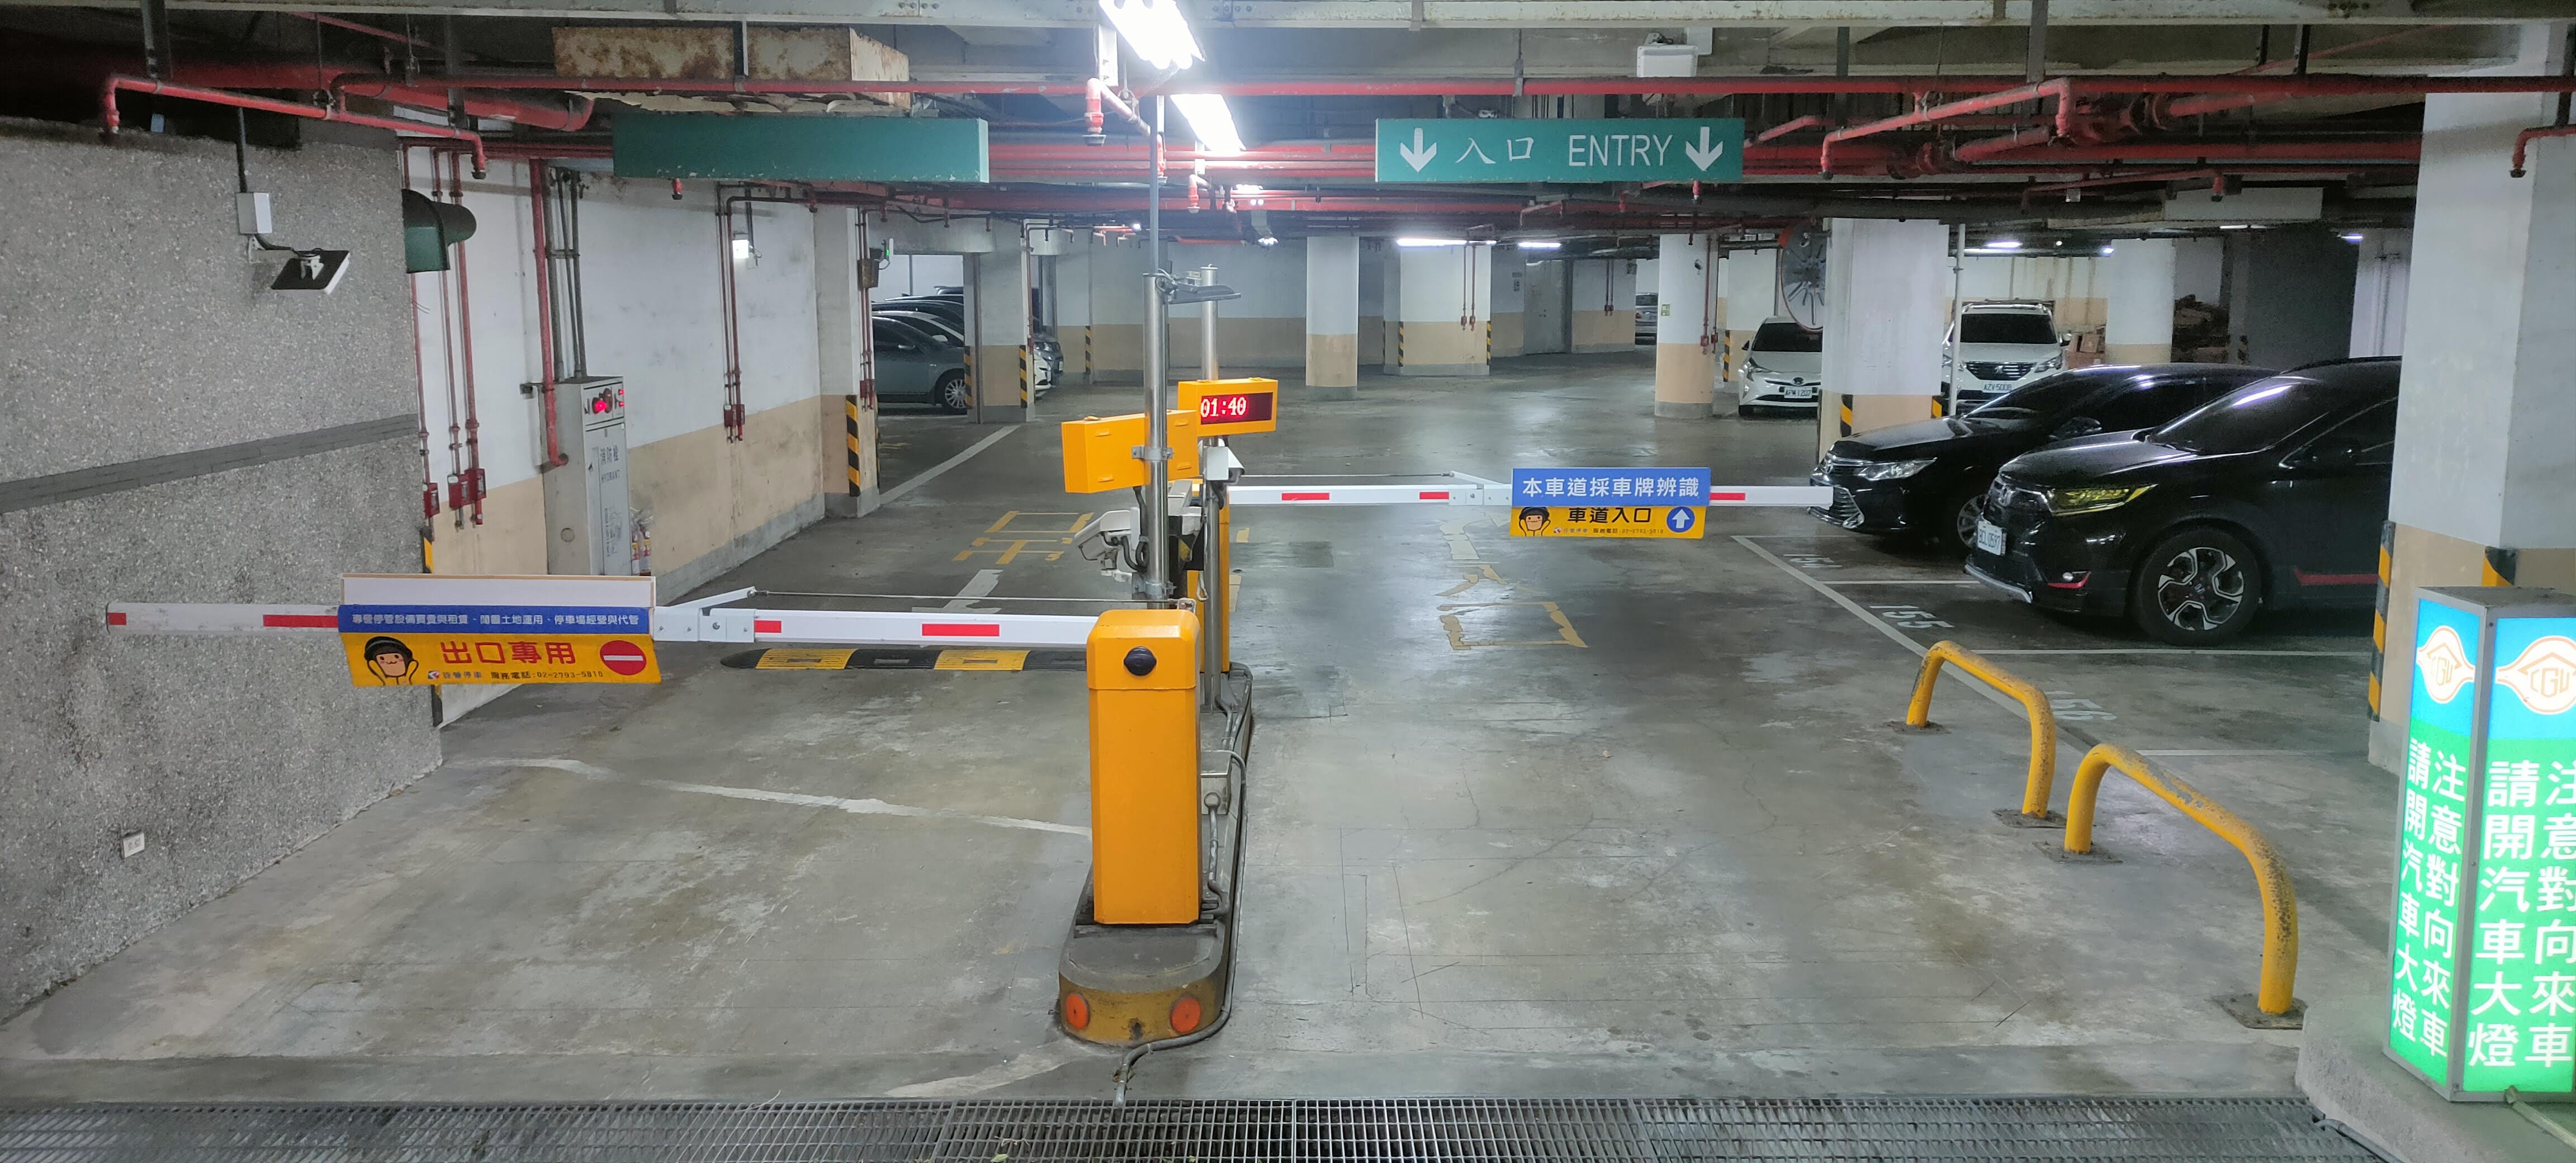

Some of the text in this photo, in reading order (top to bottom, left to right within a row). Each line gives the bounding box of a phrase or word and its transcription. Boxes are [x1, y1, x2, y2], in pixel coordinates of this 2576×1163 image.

[1456, 134, 1673, 167] 入口 ENTRY
[1200, 397, 1247, 418] 01:40
[601, 470, 620, 484] HYDRANT
[1523, 477, 1699, 498] 本車道採車牌辨識
[1567, 507, 1651, 524] 車道入口
[1869, 605, 1955, 628] 155
[441, 640, 576, 665] 出口專用
[2393, 738, 2431, 1042] 請開汽車大燈
[2419, 750, 2467, 1058] 注意對向來車
[2468, 759, 2540, 1067] 請開汽車大燈
